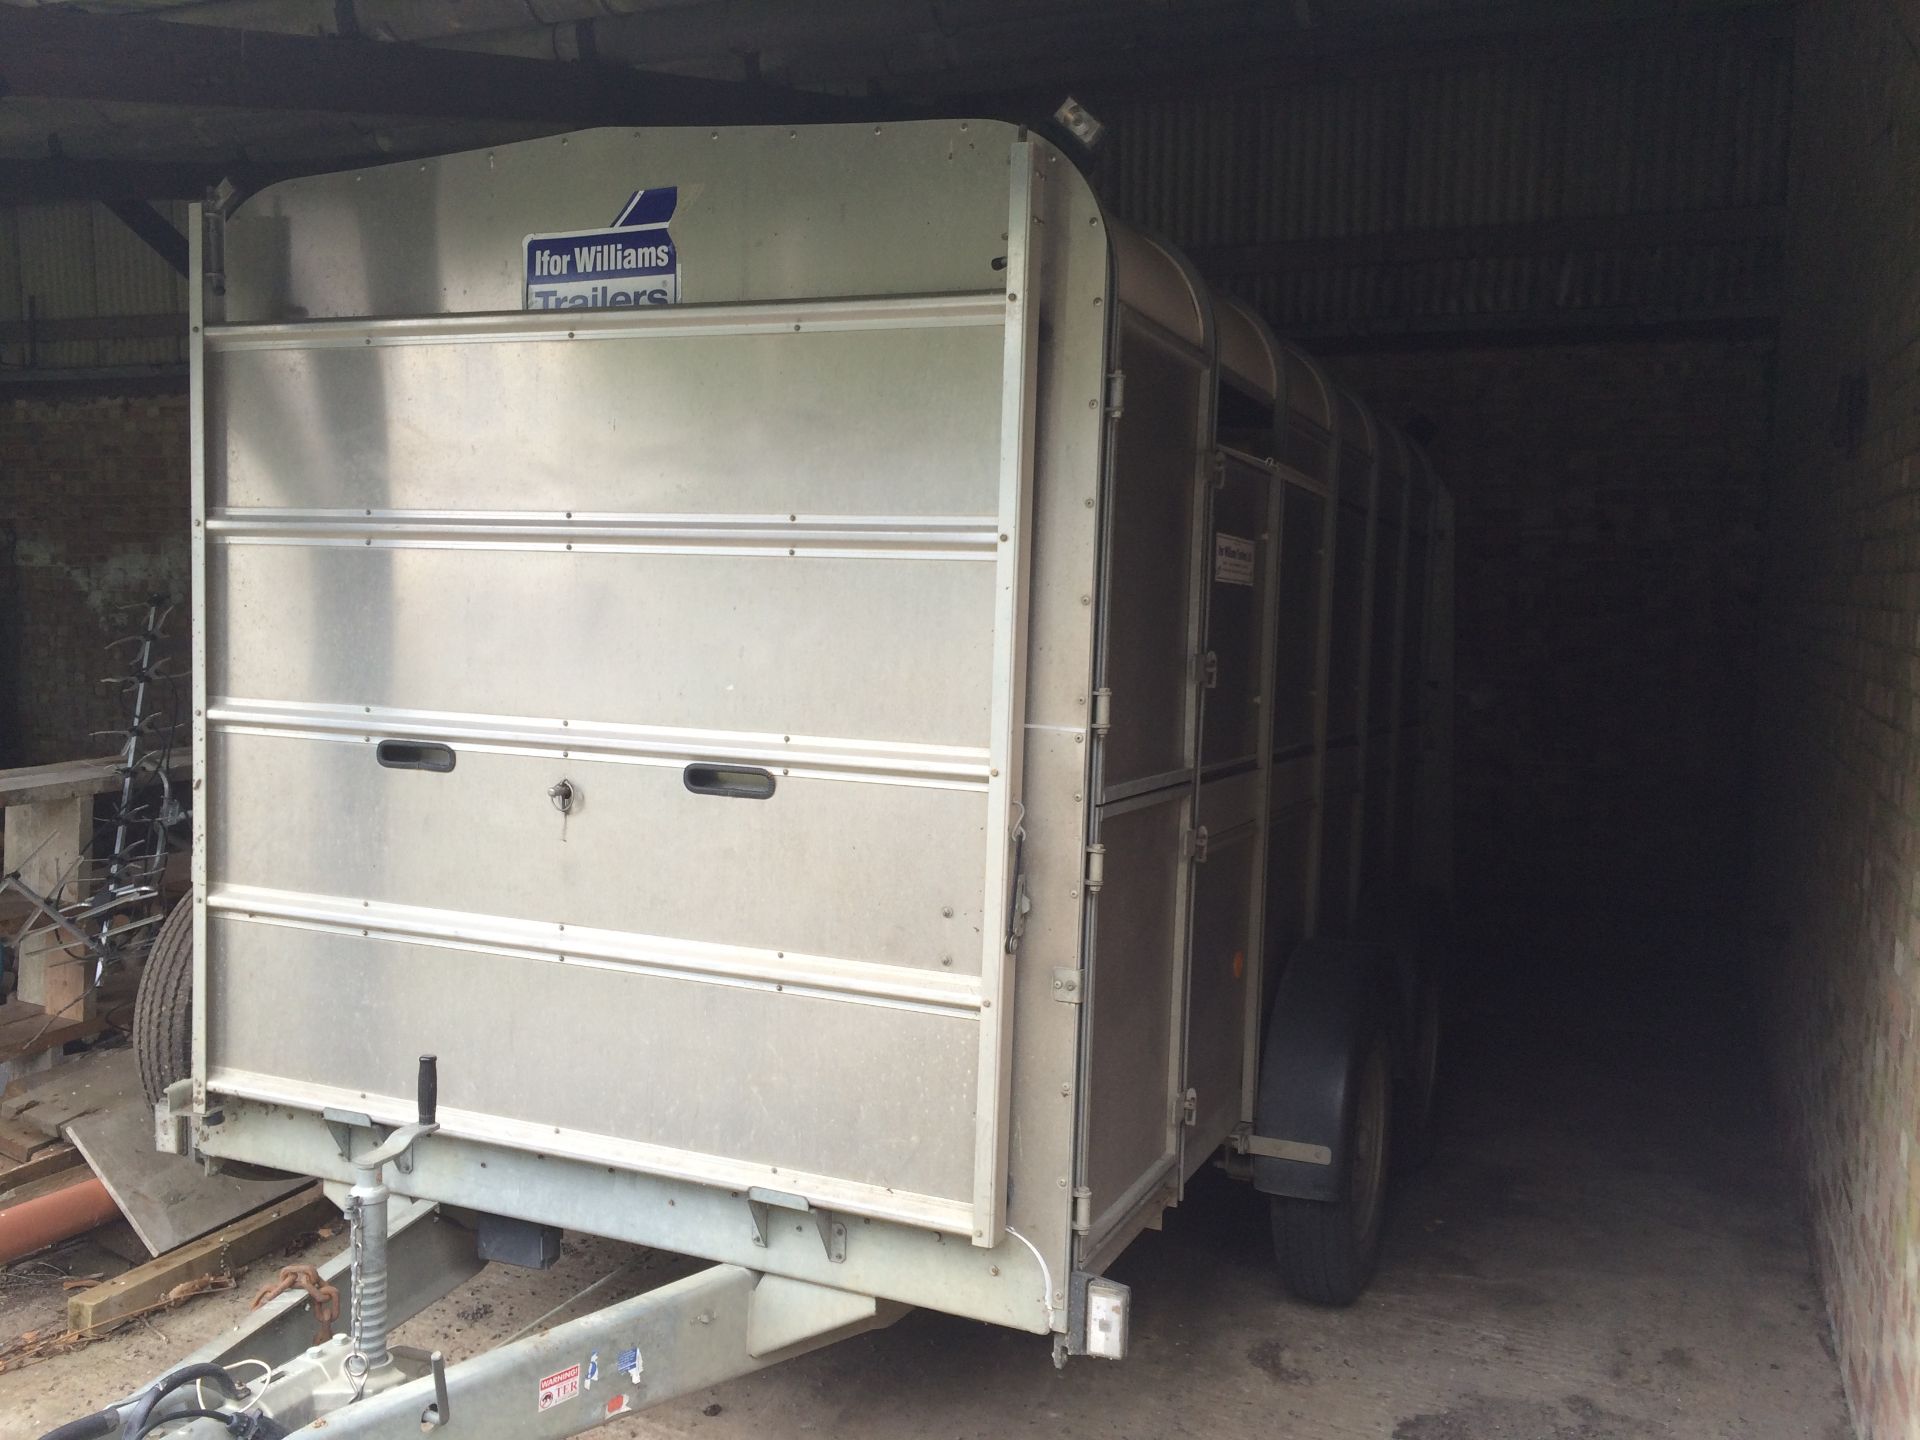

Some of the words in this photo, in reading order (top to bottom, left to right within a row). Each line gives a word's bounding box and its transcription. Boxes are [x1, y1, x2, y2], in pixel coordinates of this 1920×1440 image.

[535, 250, 570, 276] Ifor
[574, 243, 669, 273] Williams
[535, 286, 668, 308] Trailers
[541, 1367, 578, 1389] WARNING!
